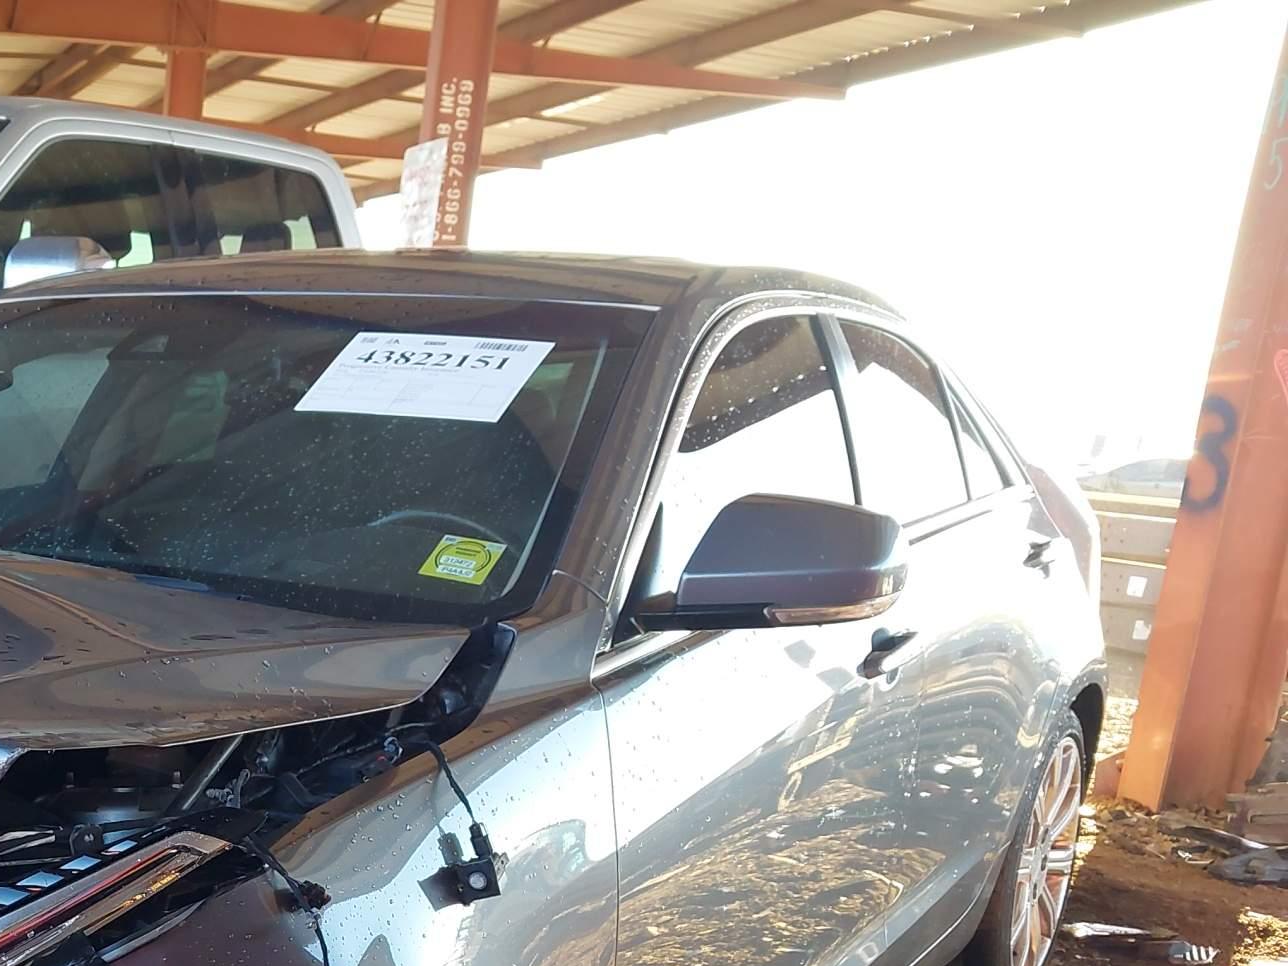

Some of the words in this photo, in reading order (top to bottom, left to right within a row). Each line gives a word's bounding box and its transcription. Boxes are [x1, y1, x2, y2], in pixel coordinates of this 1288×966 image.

[440, 77, 458, 114] INC.
[441, 79, 475, 241] 1-866-799-0969
[356, 348, 510, 371] 43822151
